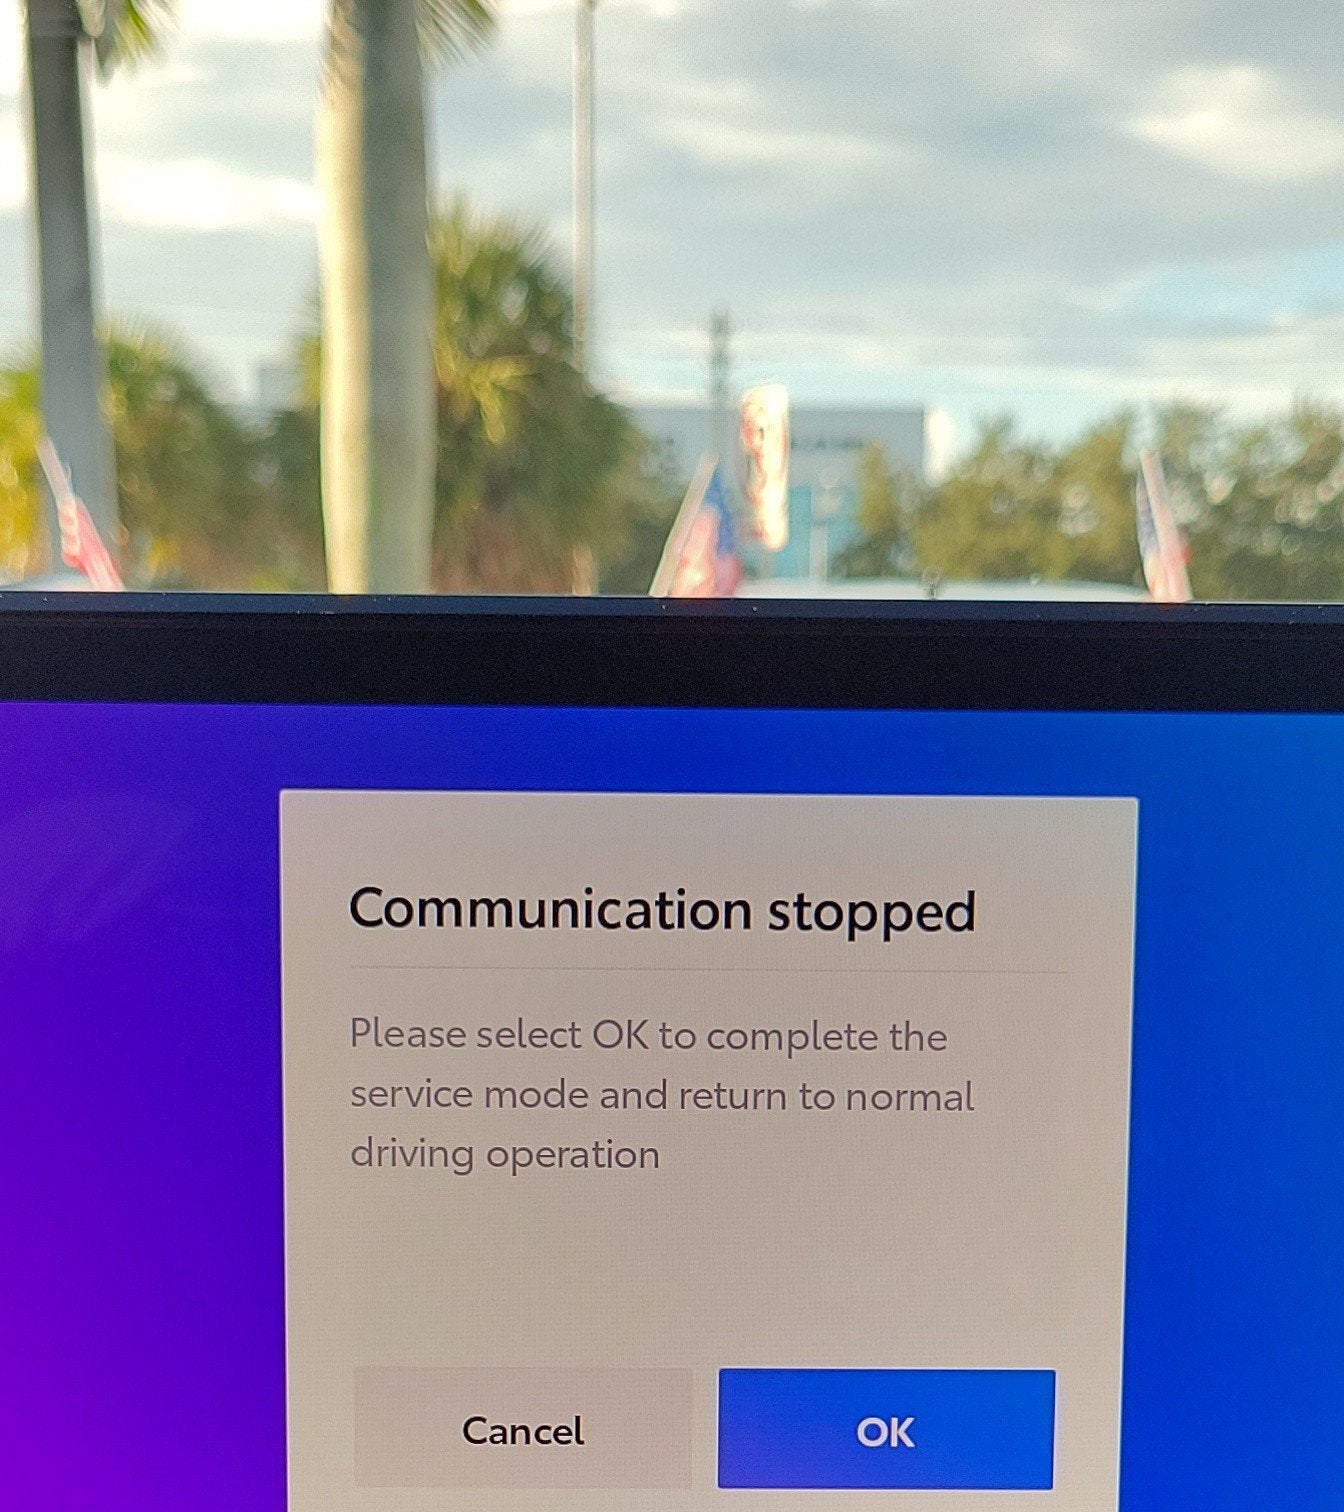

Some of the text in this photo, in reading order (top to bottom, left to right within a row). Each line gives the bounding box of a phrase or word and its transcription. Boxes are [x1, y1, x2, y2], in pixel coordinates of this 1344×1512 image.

[349, 885, 977, 943] Communication stopped
[350, 1015, 949, 1061] Please select OK to complete the
[350, 1077, 975, 1113] service mode and return to normal
[350, 1136, 661, 1177] driving operation
[461, 1414, 916, 1449] Cancel OK
